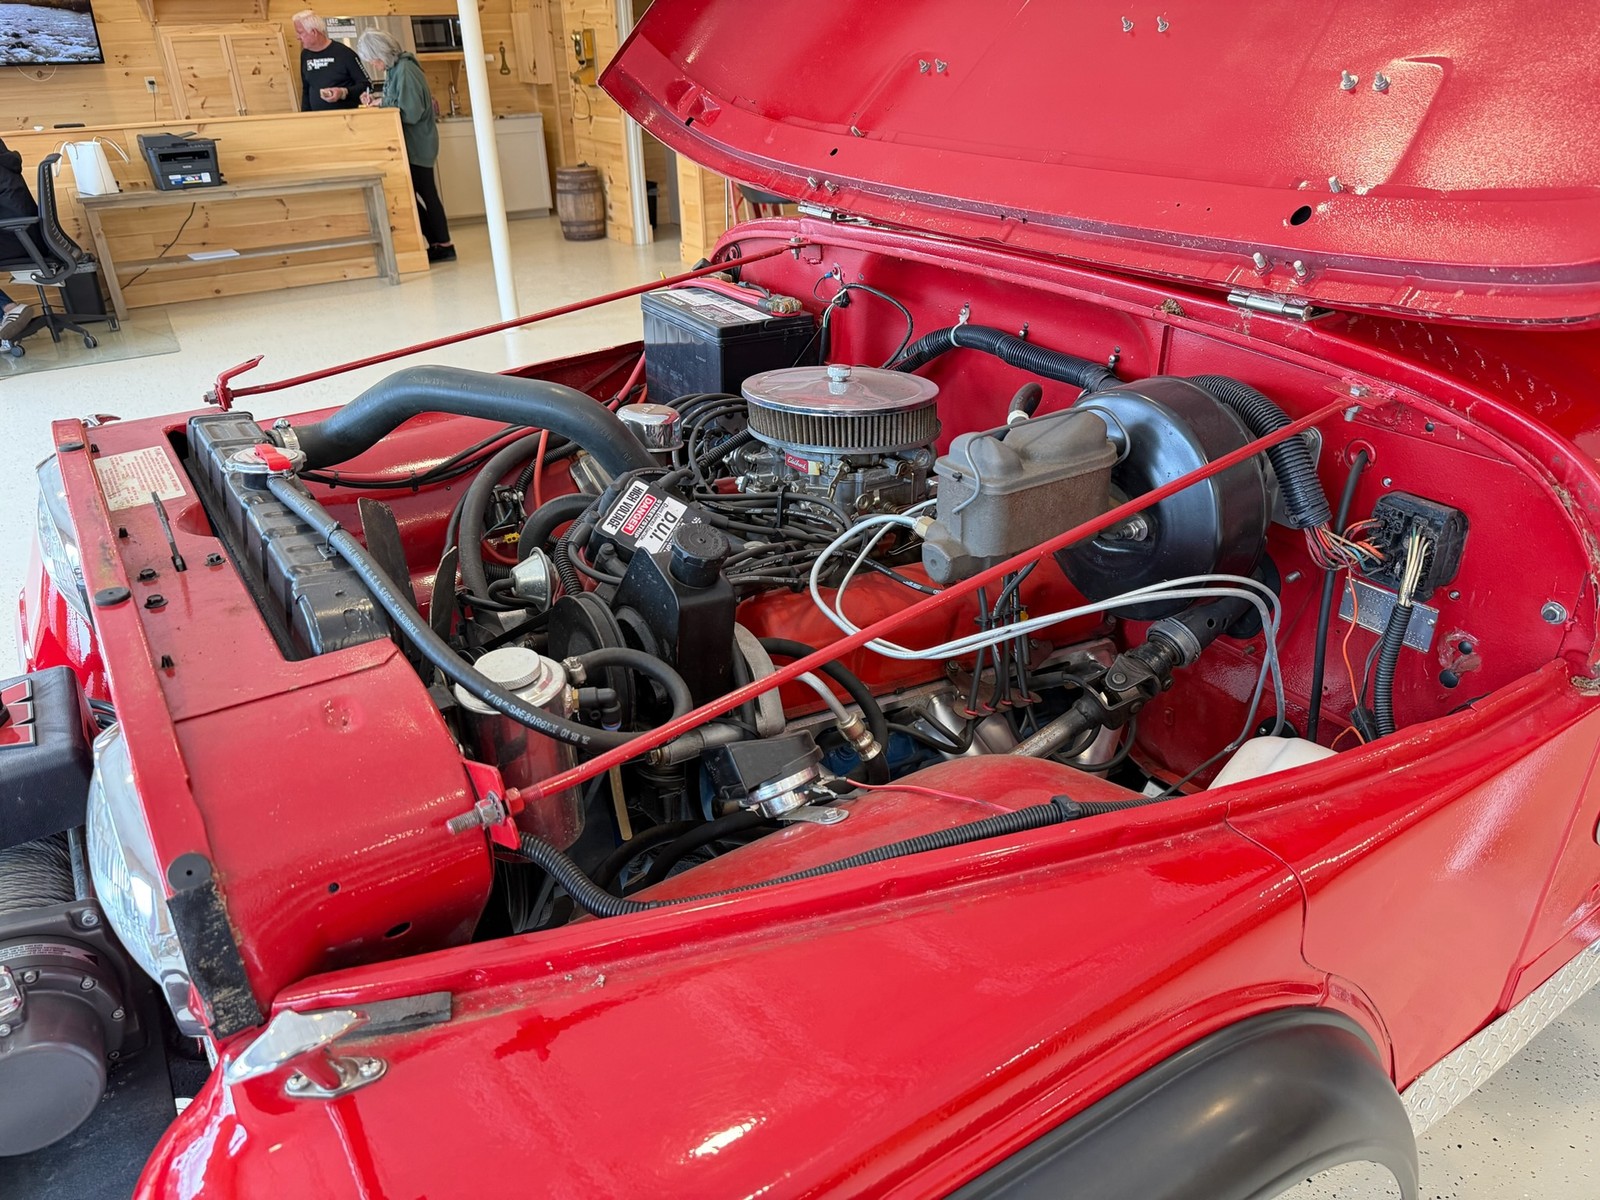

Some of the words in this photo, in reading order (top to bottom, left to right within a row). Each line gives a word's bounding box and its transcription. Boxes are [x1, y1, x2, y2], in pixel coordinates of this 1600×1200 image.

[627, 485, 645, 503] HIGH
[606, 501, 632, 530] VOLTAGE
[625, 498, 653, 531] DANGER
[634, 499, 663, 539] STREET/STRIP
[649, 510, 678, 542] D.U.I.
